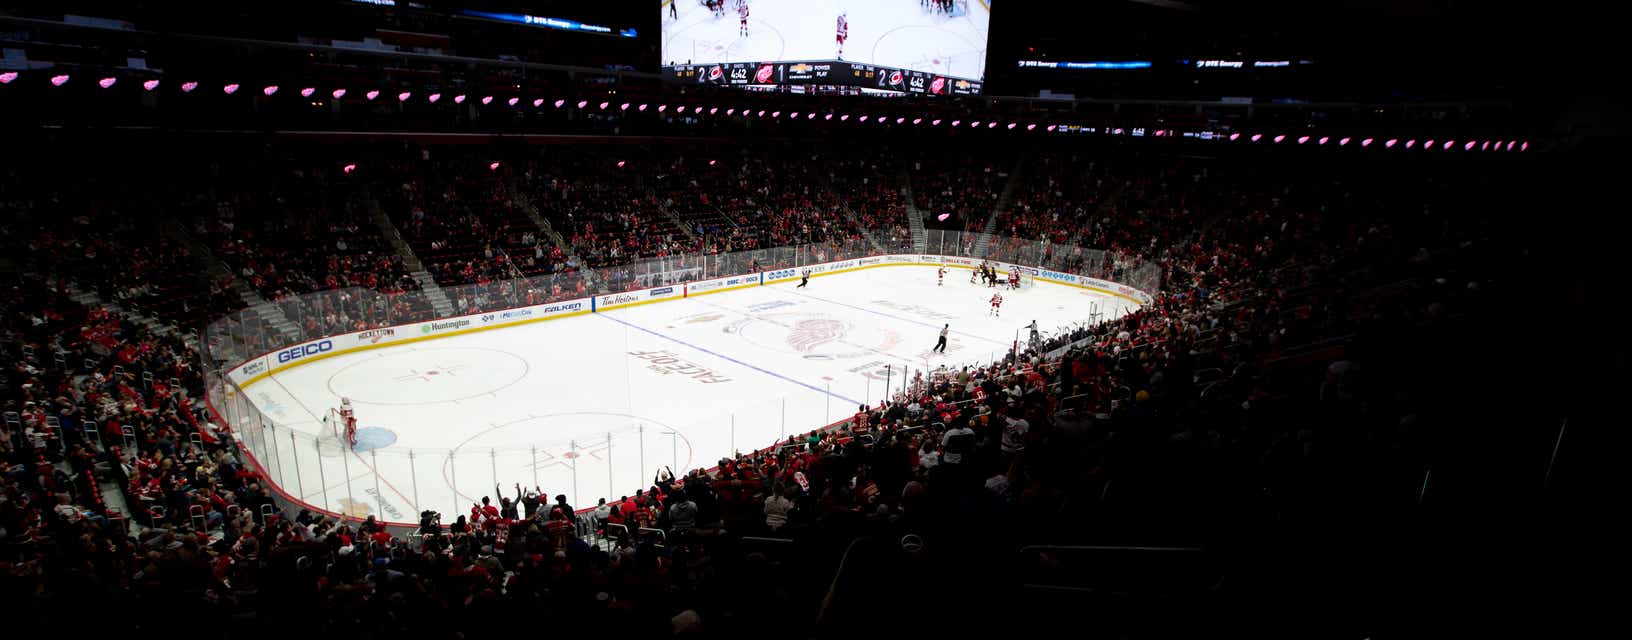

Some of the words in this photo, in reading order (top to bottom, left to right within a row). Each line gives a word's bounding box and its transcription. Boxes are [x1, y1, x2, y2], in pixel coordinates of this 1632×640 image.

[699, 67, 705, 83] 2
[731, 69, 746, 79] 4:42
[778, 65, 783, 83] 1
[879, 70, 886, 87] 2
[910, 77, 924, 88] 4:42
[947, 79, 952, 94] 1
[602, 295, 614, 306] Tim
[615, 294, 639, 304] Hortons
[544, 302, 582, 313] FALKEN
[431, 318, 470, 332] Huntington
[277, 339, 333, 364] GEICO
